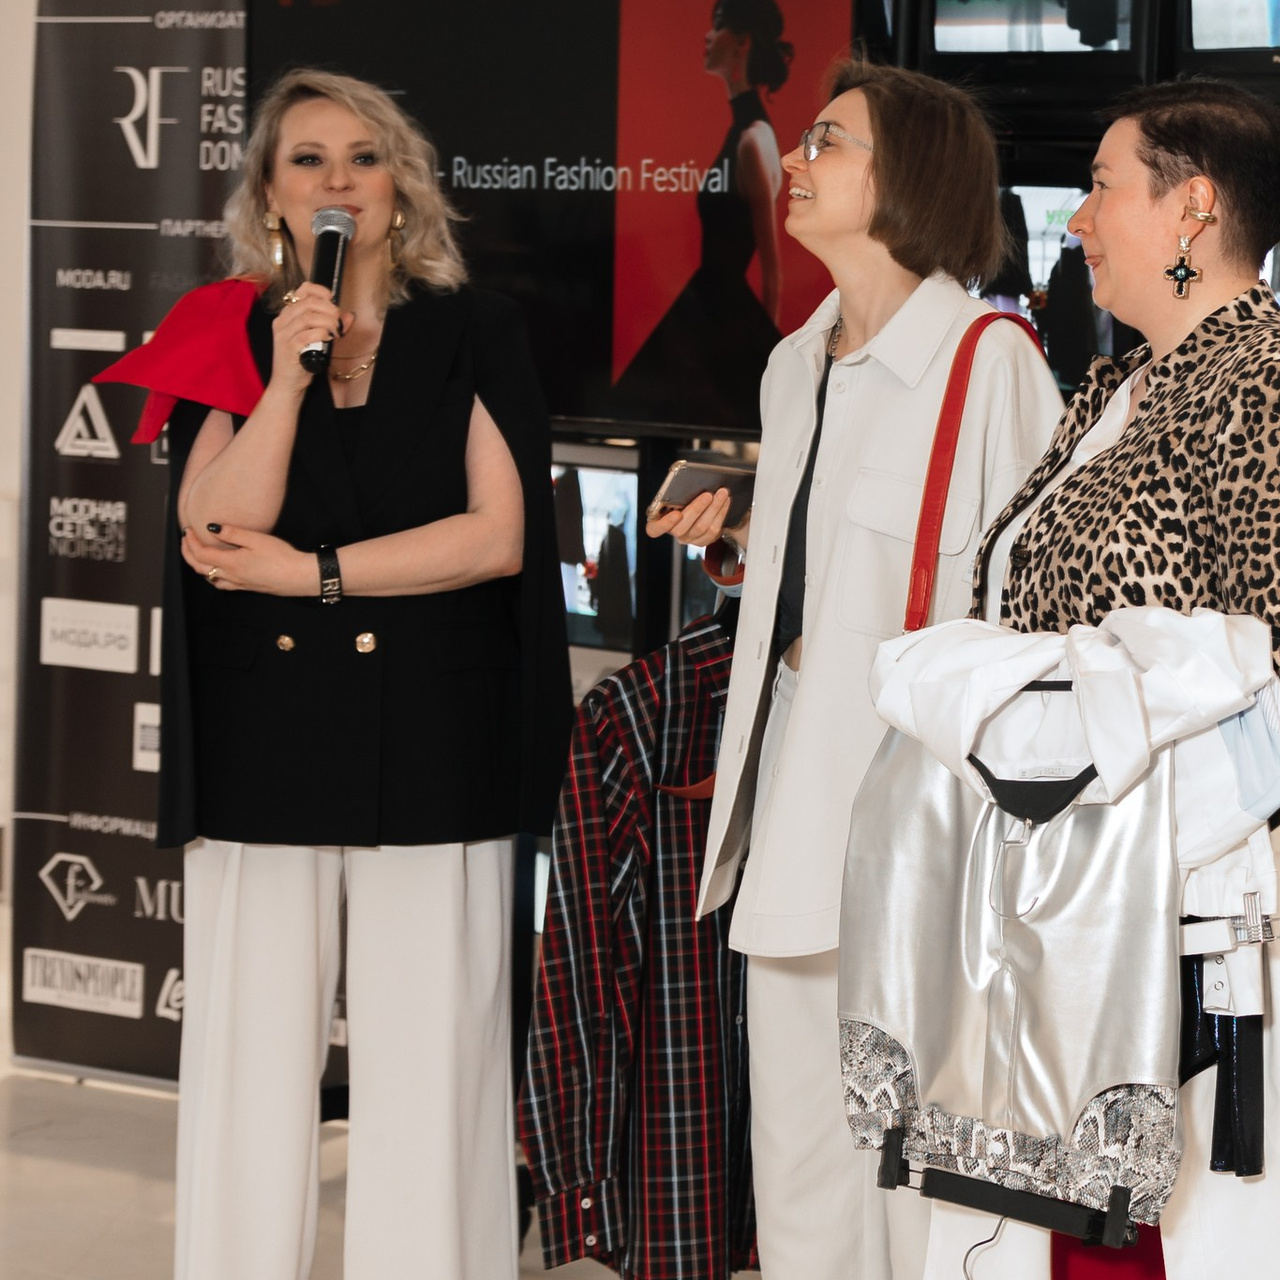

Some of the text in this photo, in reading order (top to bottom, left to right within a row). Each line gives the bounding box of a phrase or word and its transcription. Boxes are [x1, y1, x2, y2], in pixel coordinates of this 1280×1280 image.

[452, 157, 536, 189] Russian
[544, 157, 632, 191] Fashion
[641, 158, 728, 193] Festival
